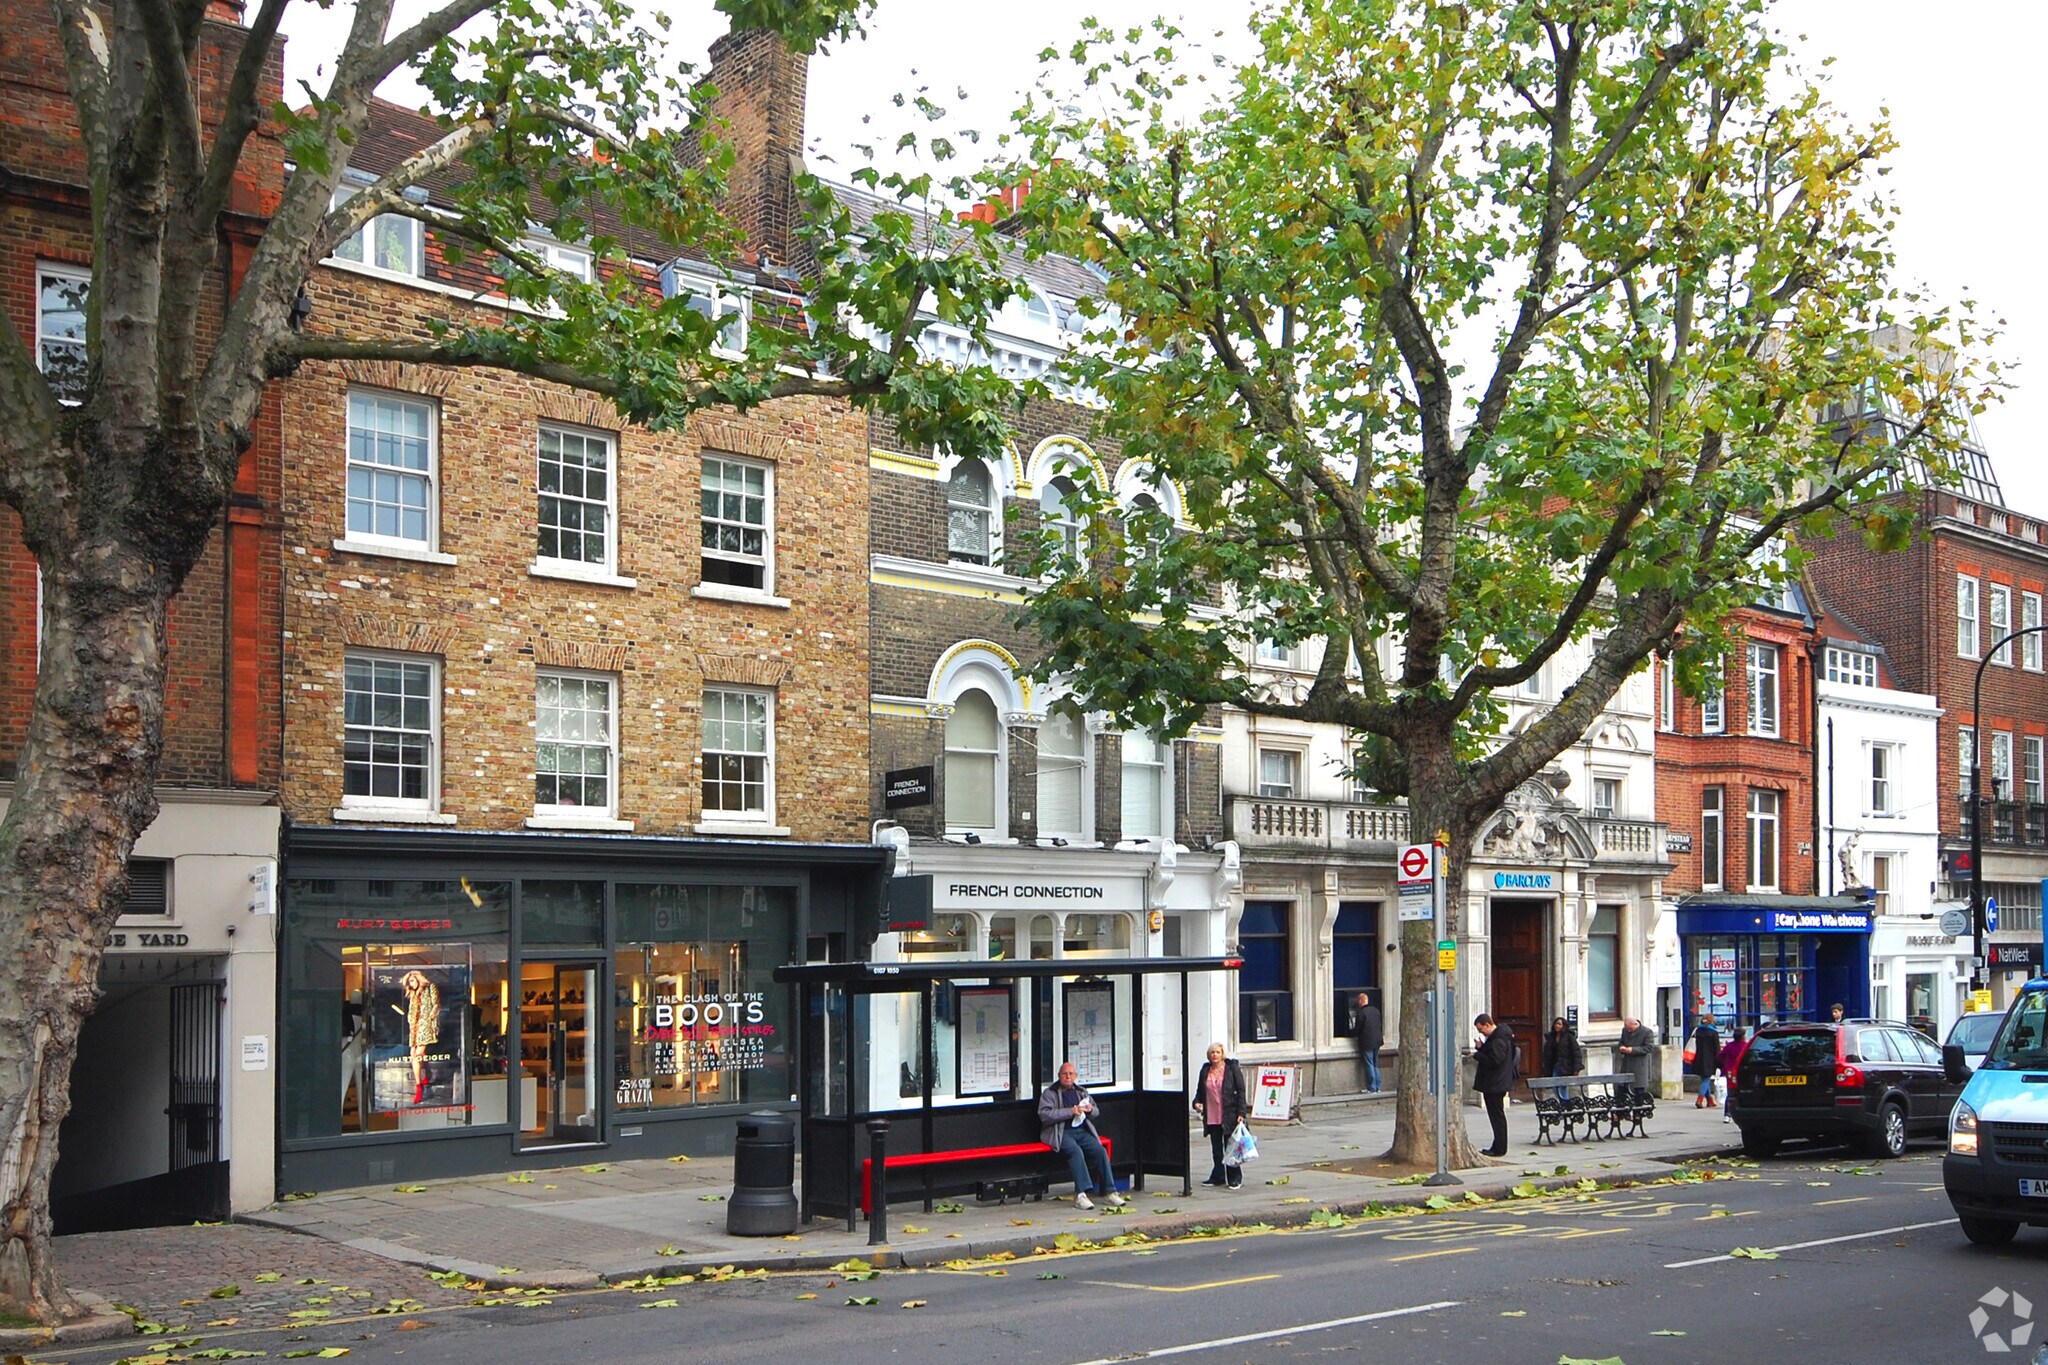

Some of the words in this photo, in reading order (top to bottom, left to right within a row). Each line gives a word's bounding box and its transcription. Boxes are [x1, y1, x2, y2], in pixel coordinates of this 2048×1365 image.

[894, 779, 919, 789] FRENCH
[887, 786, 926, 797] CONNECTION
[1505, 873, 1551, 888] BARCLAYS
[950, 884, 1008, 897] FRENCH
[1013, 885, 1103, 898] CONNECTION
[390, 919, 452, 930] GEIGER
[138, 934, 189, 947] YARD
[1998, 947, 2029, 962] NatWest
[656, 995, 678, 1004] THE
[684, 994, 718, 1003] CLASH
[724, 993, 738, 1001] OF
[743, 992, 764, 1001] THE
[656, 1001, 764, 1027] BOOTS
[417, 1053, 451, 1062] GEIGER
[655, 1048, 695, 1056] RIDNG
[619, 1079, 638, 1090] 25%
[616, 1089, 653, 1104] GRAZIA
